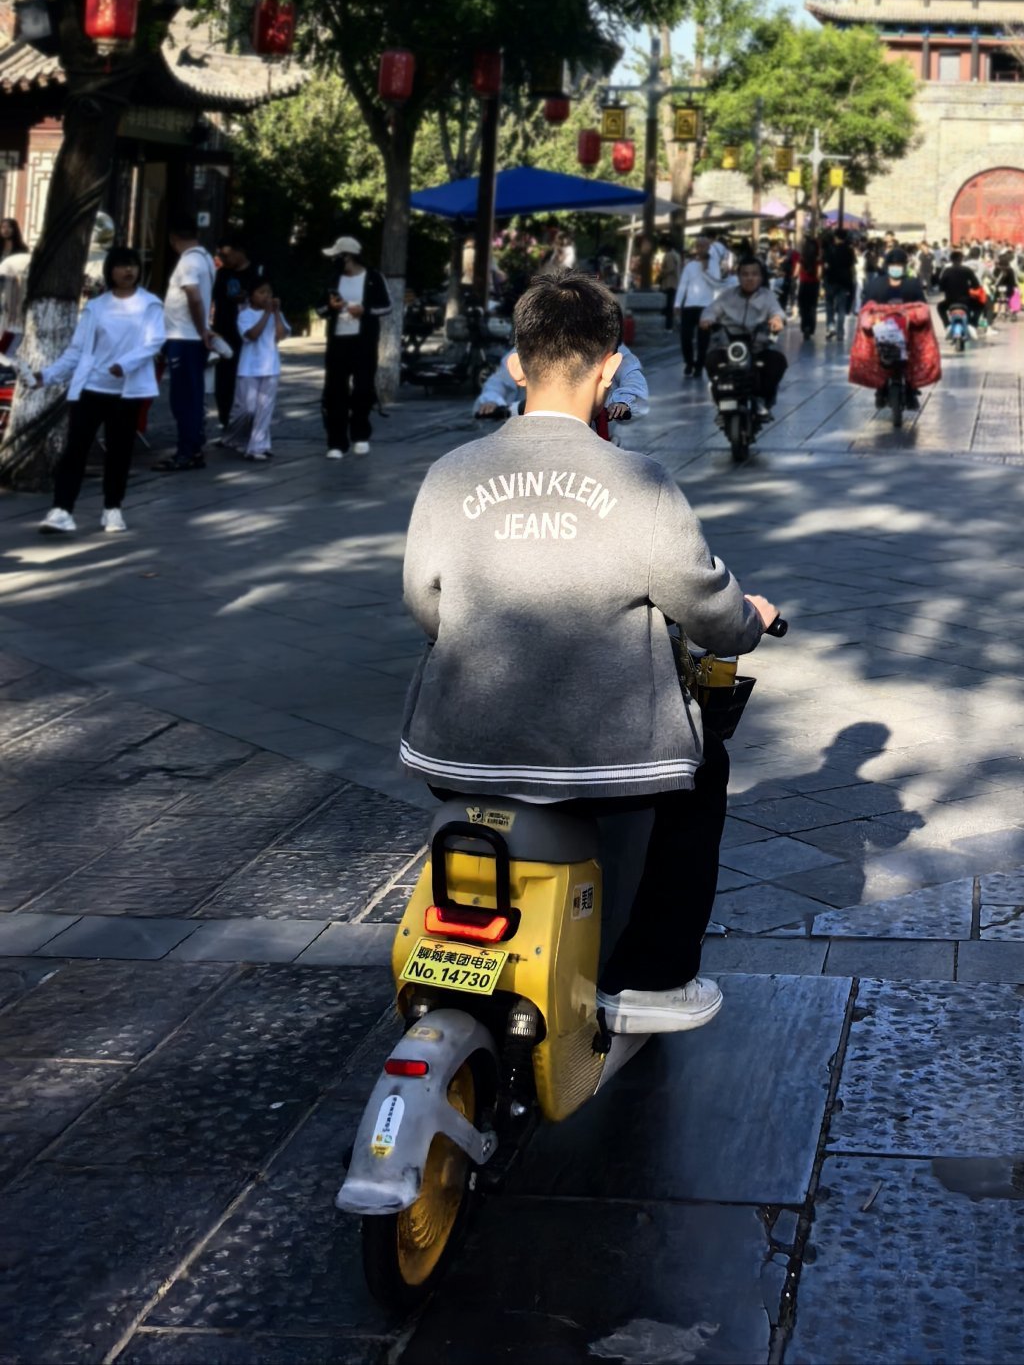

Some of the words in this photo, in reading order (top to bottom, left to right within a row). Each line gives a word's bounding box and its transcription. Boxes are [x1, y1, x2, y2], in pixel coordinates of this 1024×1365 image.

[463, 471, 544, 520] CALVIN
[546, 471, 618, 520] KLEIN
[494, 511, 578, 540] JEANS
[416, 946, 498, 972] 聊城美团电动
[408, 961, 491, 988] No.14730
